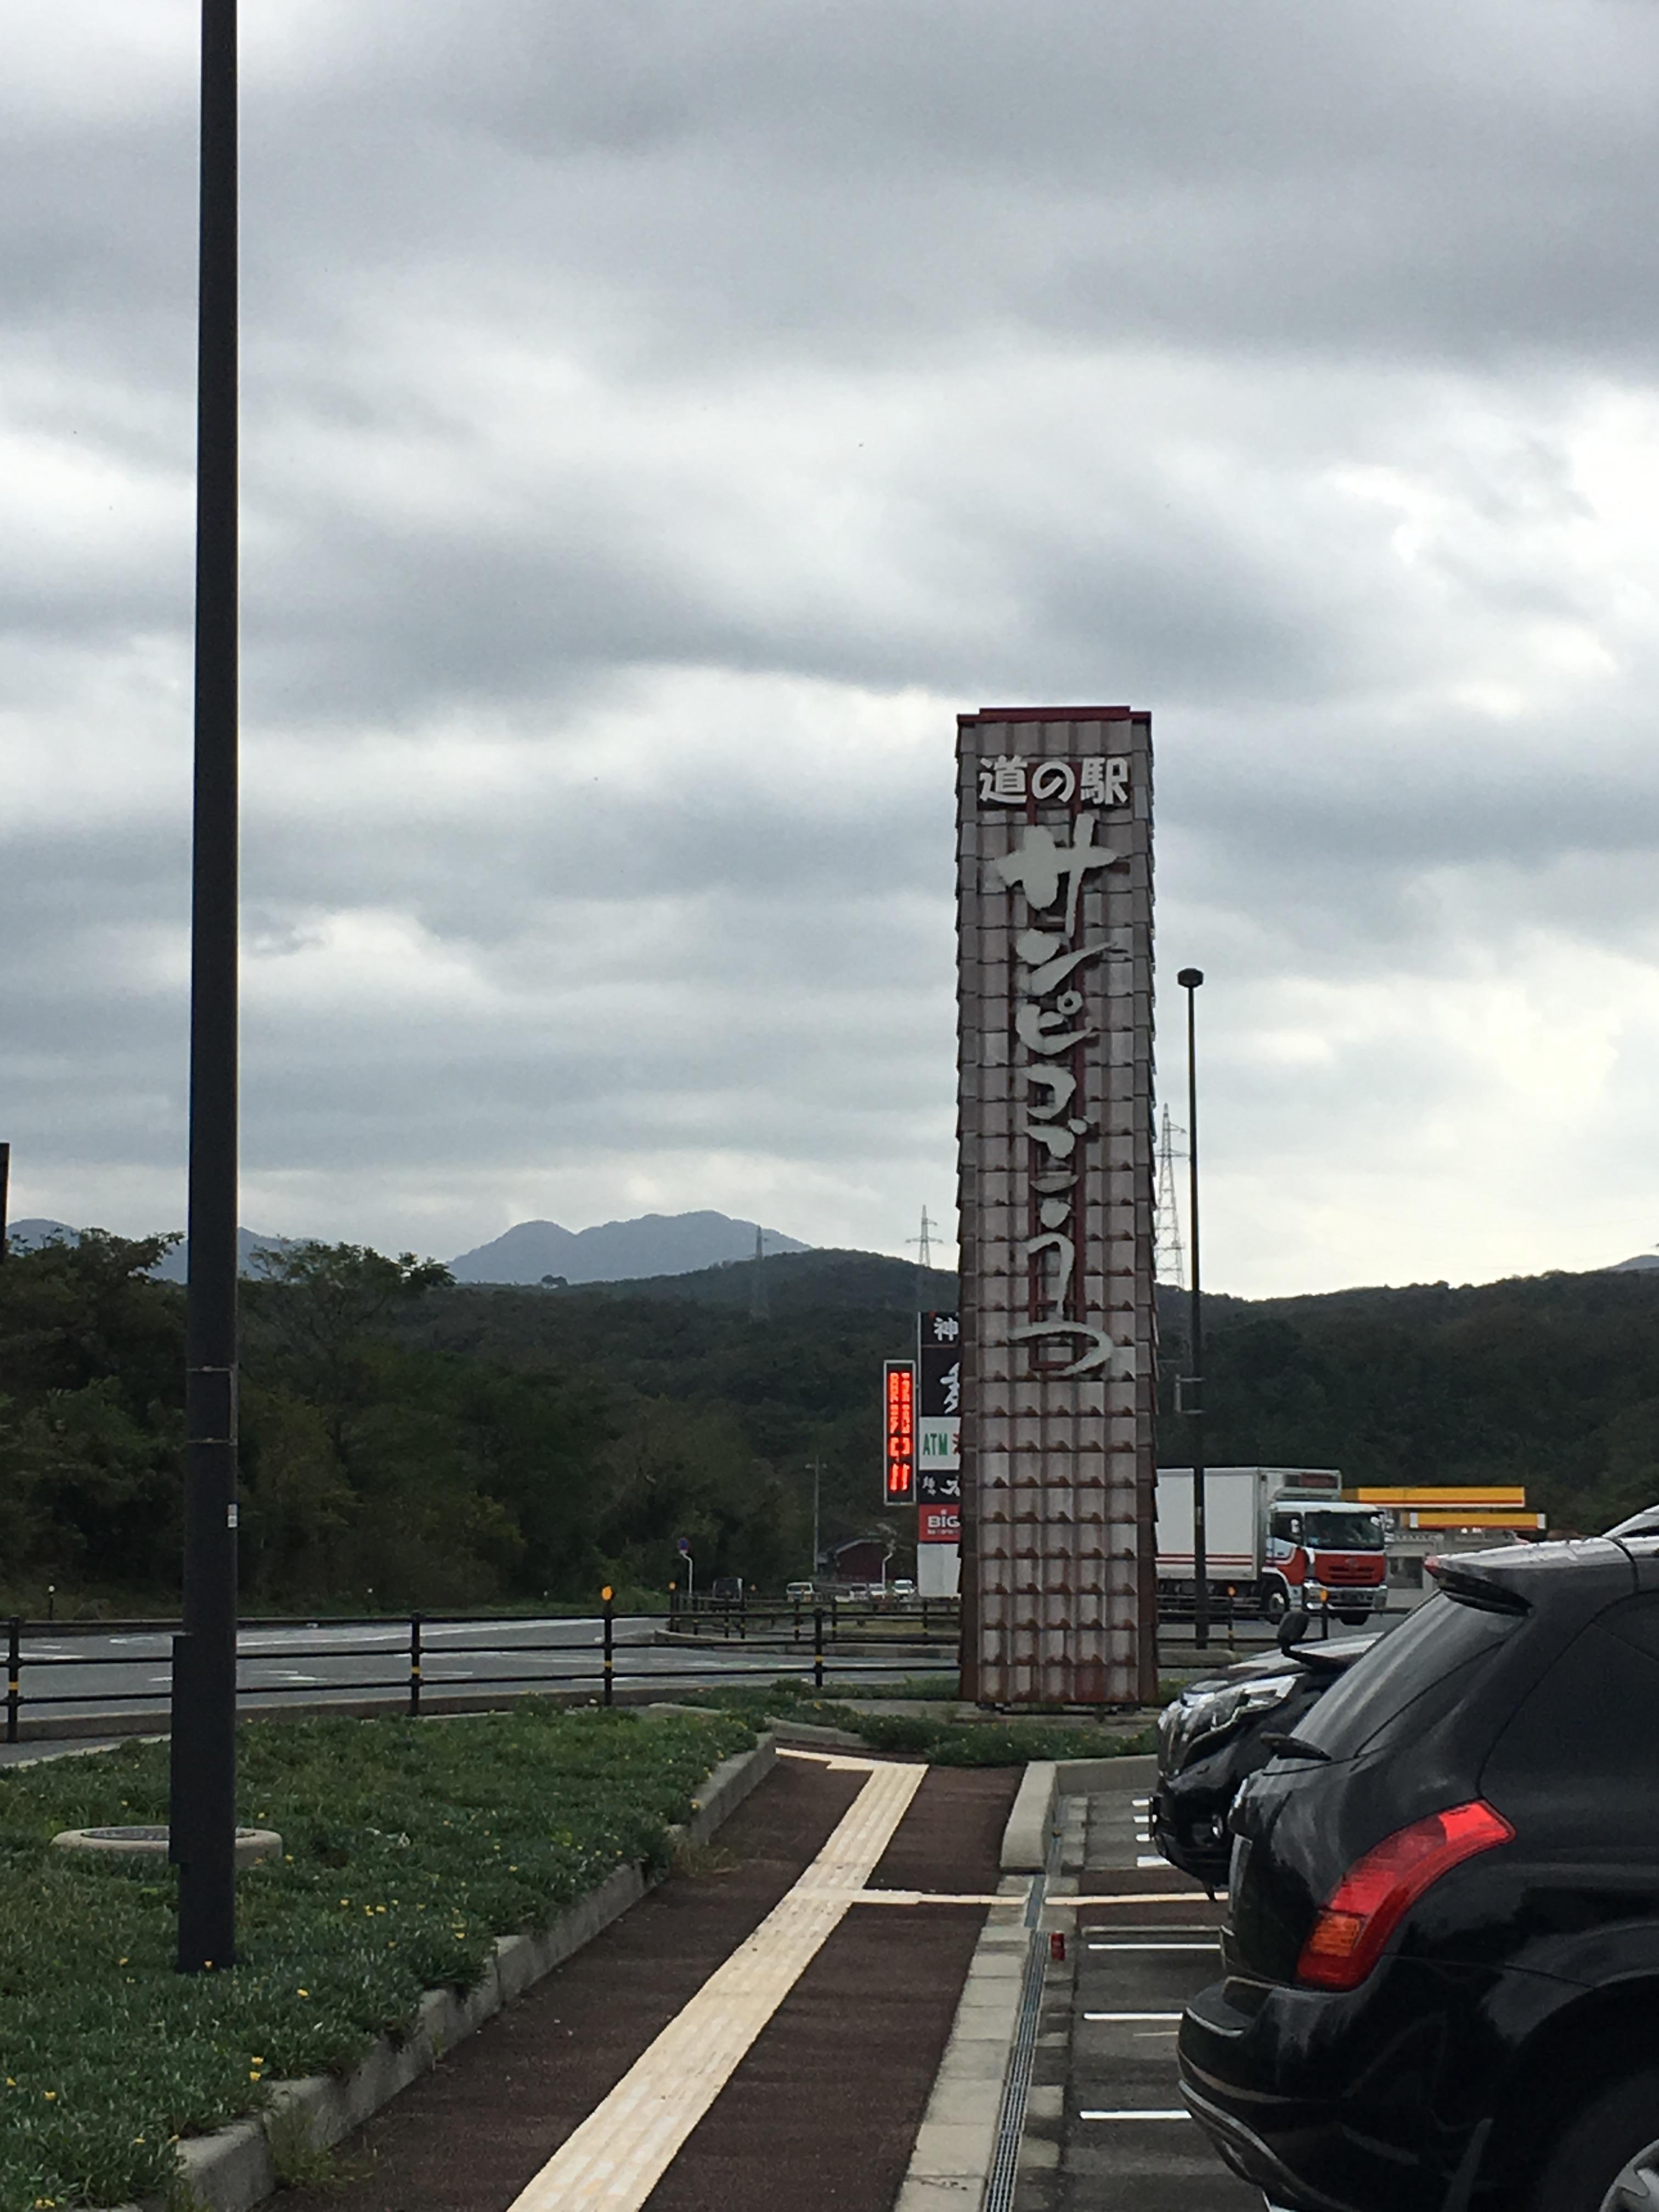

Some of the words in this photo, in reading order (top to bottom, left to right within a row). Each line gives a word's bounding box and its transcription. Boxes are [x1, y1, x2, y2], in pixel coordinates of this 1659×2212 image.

[979, 755, 1128, 805] 道の駅
[923, 1433, 948, 1455] ATM
